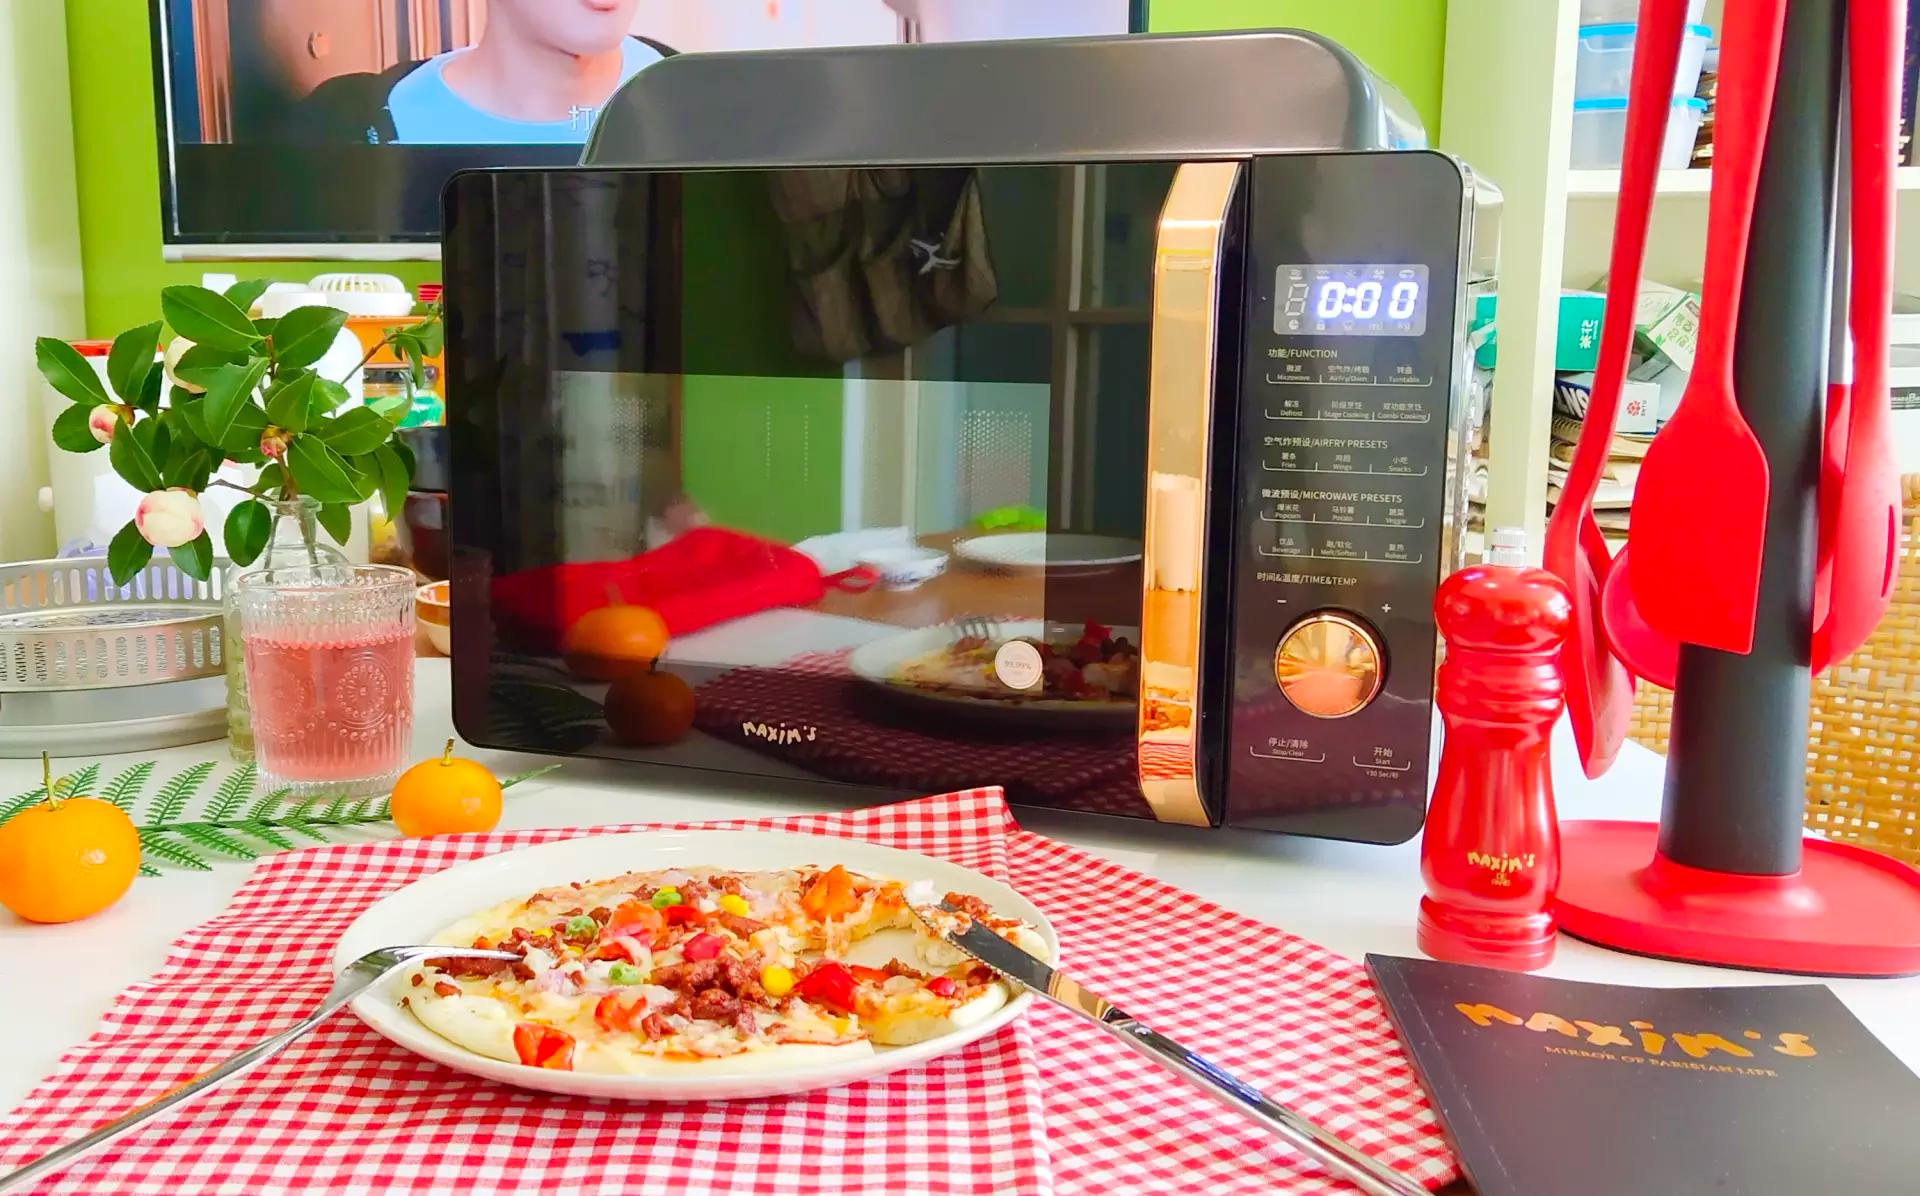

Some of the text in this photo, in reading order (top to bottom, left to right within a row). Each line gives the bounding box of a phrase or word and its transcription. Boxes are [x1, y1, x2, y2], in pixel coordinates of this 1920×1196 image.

[1317, 282, 1419, 319] 0:00
[1267, 349, 1338, 359] 功能/FUNCTION
[1280, 409, 1304, 417] Defrost
[1343, 412, 1369, 420] Cooking
[1400, 413, 1427, 422] Cooking
[1263, 436, 1388, 449] 空气炸预设/AIRFRY PRESETS
[1333, 463, 1352, 471] Wings
[1262, 488, 1402, 503] 微波预设/MICROWAVE PRESETS
[1272, 546, 1300, 554] Beverage
[1256, 572, 1357, 586] 时间&温度/TIME&TEMP
[1268, 737, 1308, 750] 停止/清除
[1272, 749, 1305, 758] Stop/Clear
[1373, 746, 1393, 758] 开始
[1544, 1045, 1779, 1077] MIRROR OF PARISIAN LIFE
